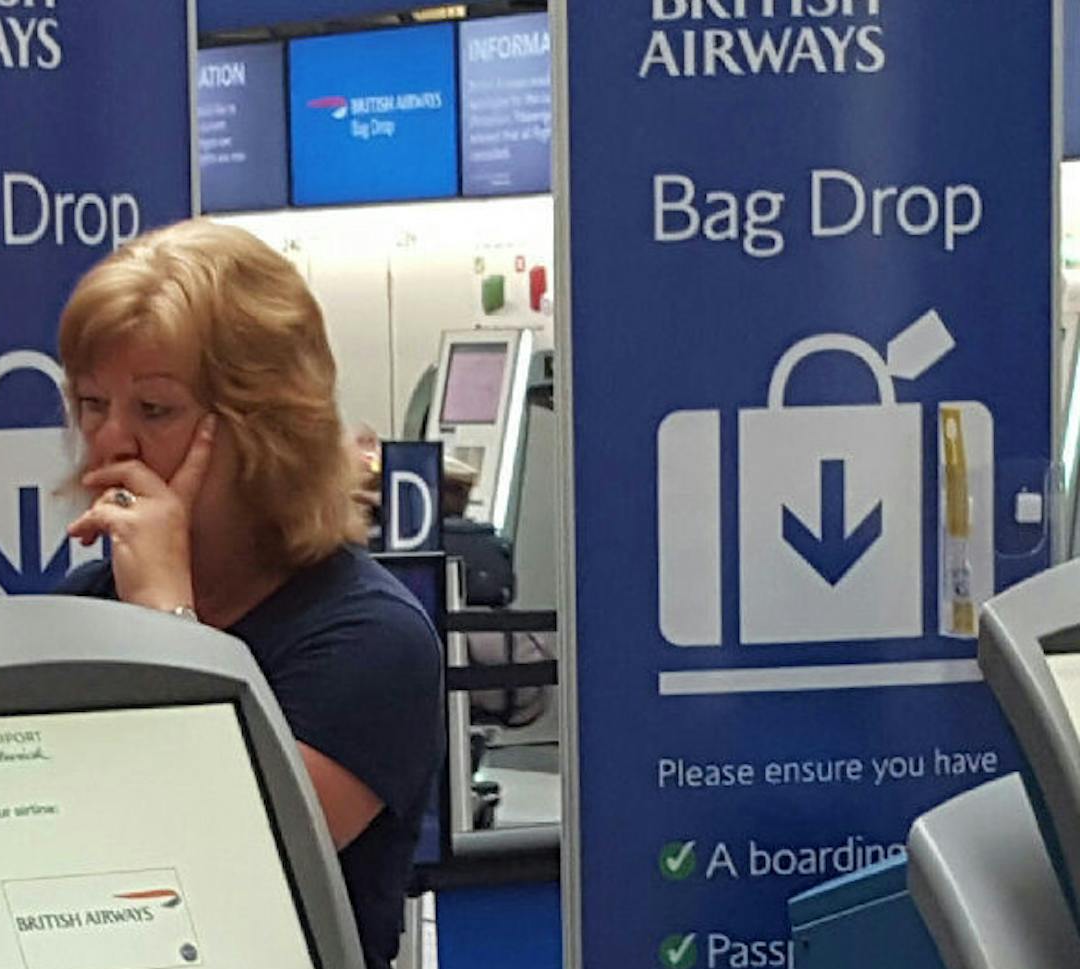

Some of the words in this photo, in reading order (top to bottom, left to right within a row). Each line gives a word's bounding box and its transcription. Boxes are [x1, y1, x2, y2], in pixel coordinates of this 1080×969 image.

[638, 25, 886, 78] AIRWAYS
[350, 94, 394, 115] BRITISH
[395, 91, 442, 112] AIRWAYS
[3, 171, 140, 249] Drop
[653, 173, 784, 258] Bag
[811, 169, 983, 251] Drop
[390, 471, 433, 549] D
[658, 758, 754, 788] Please
[765, 758, 863, 784] ensure
[872, 757, 924, 786] you
[934, 748, 998, 775] have
[706, 842, 739, 879] A
[16, 913, 82, 931] BRITISH
[85, 906, 154, 925] AIRWAYS
